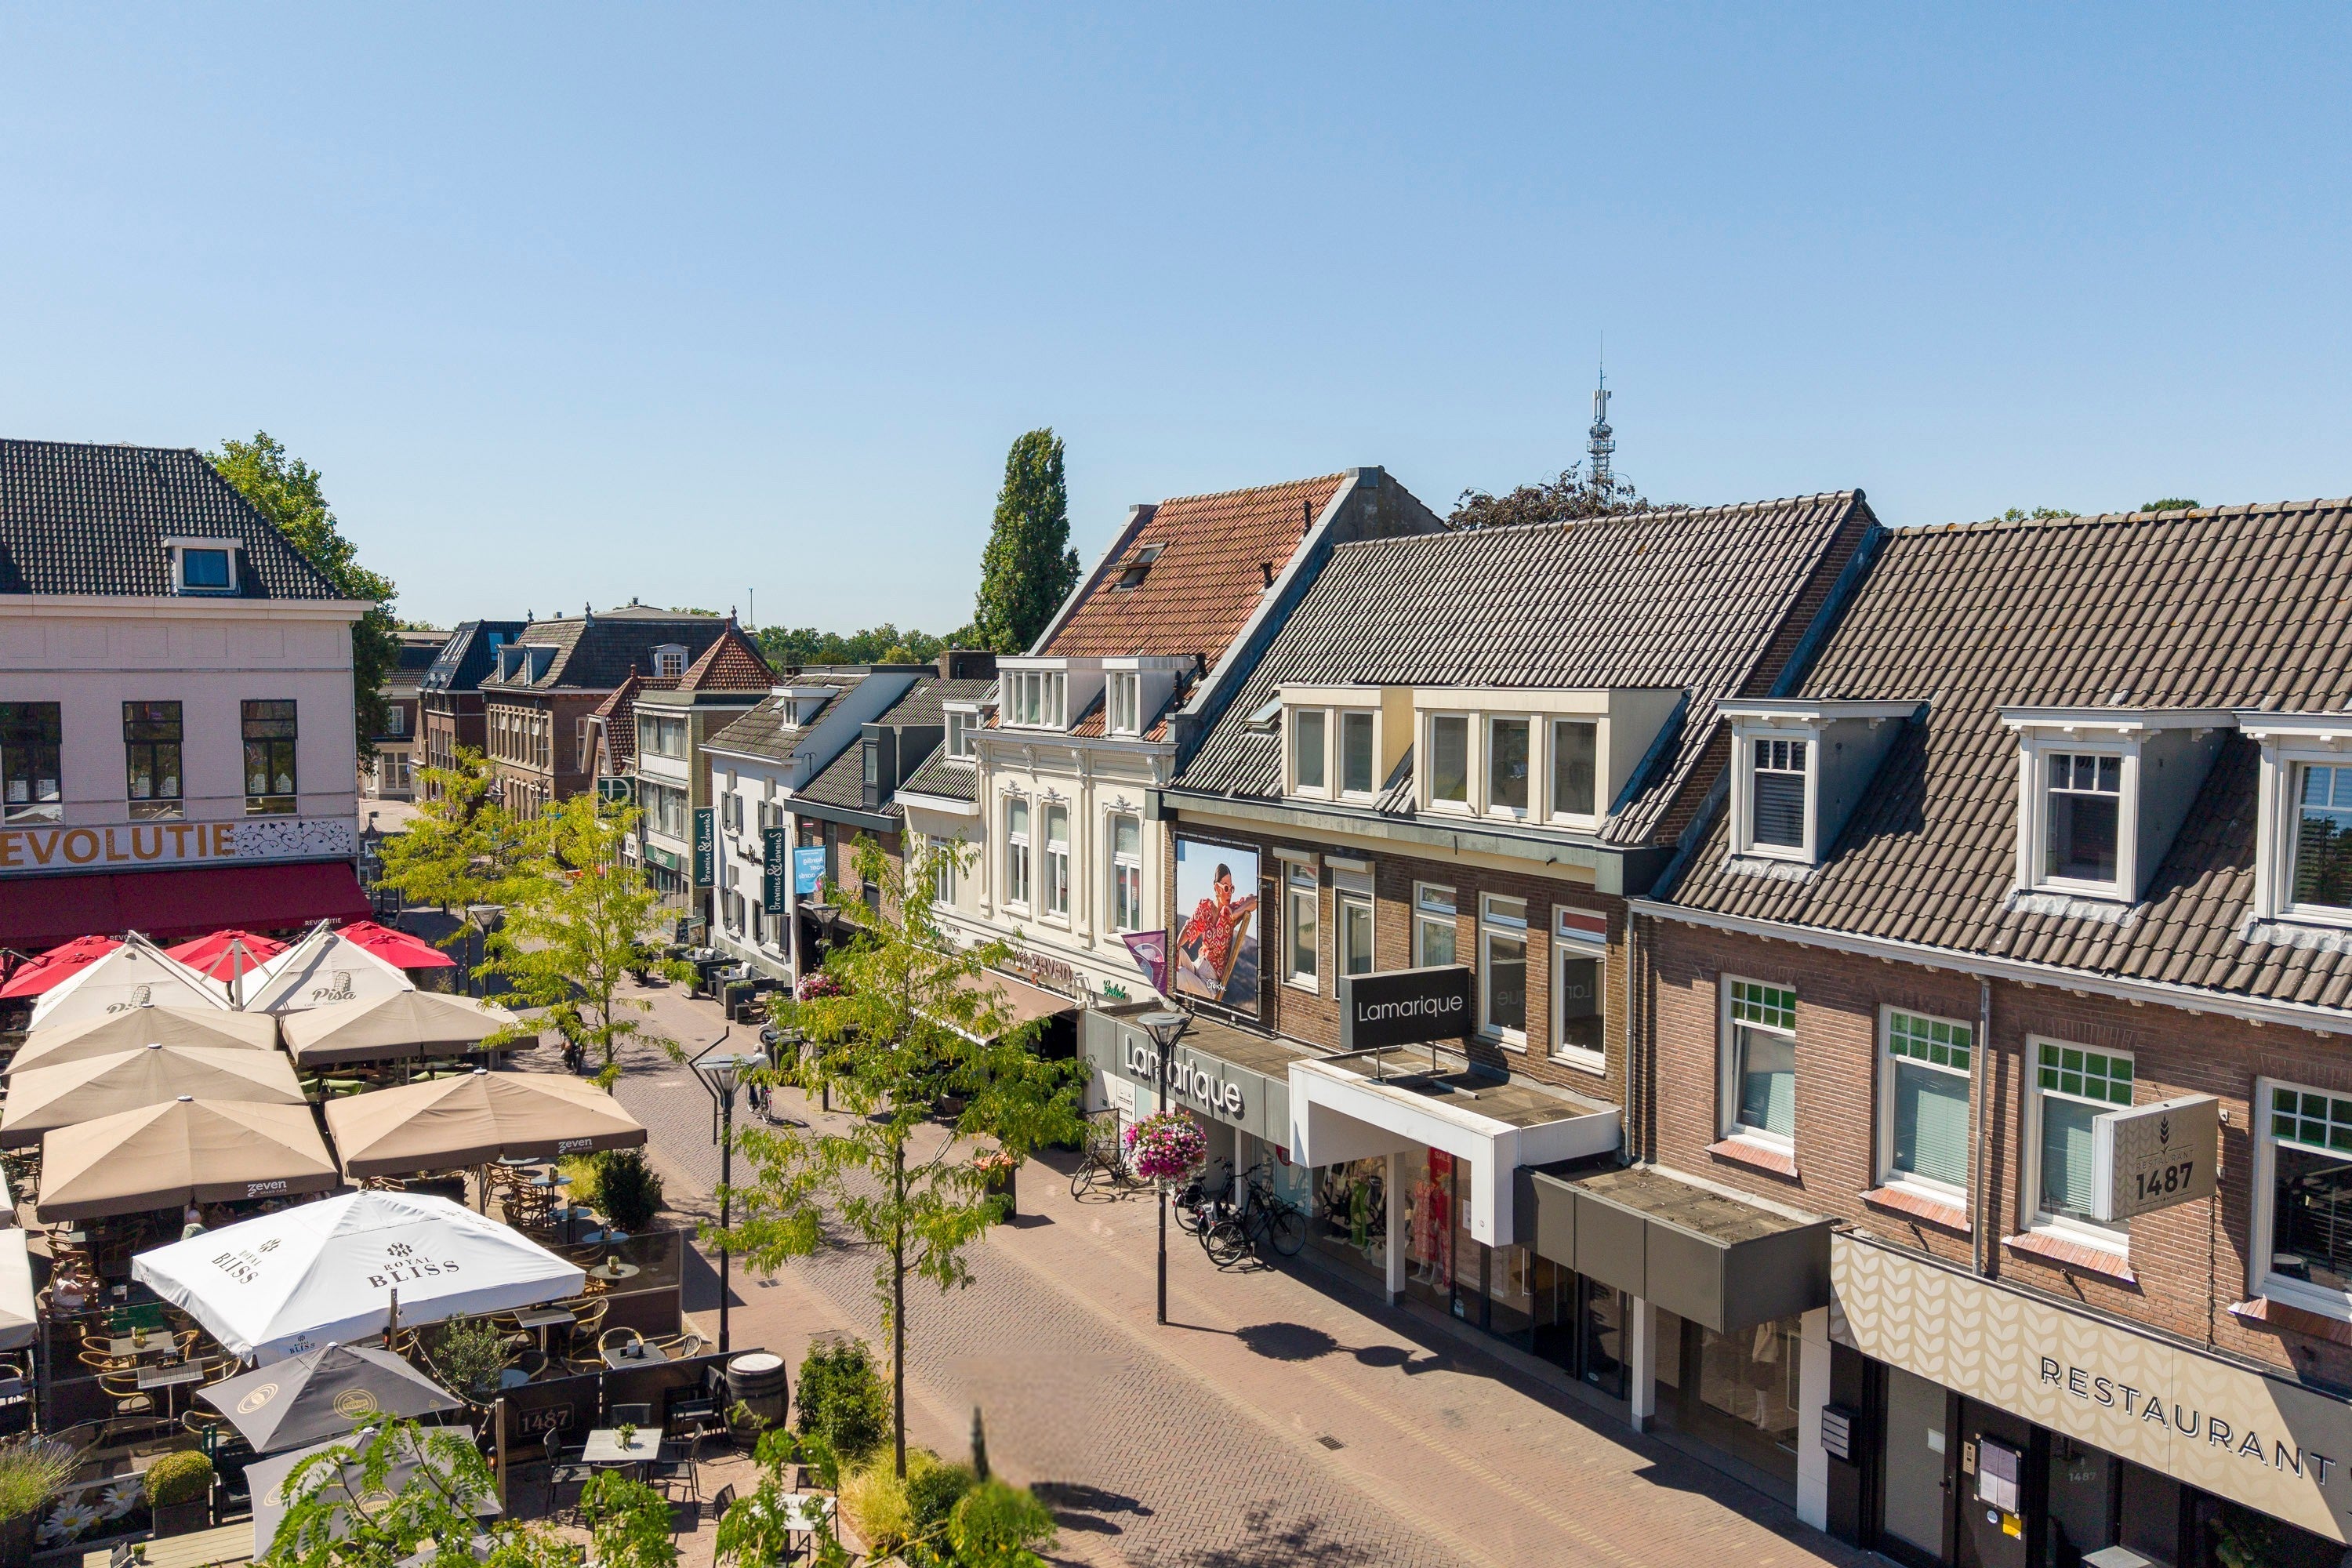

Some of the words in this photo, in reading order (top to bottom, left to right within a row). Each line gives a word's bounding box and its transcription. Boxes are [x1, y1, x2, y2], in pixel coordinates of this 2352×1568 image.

[699, 852, 711, 883] Brownies
[768, 877, 781, 910] Brownies
[312, 988, 356, 1002] Pisa
[1359, 995, 1463, 1022] Lamarique
[1125, 1034, 1241, 1112] Lamarique
[558, 1138, 593, 1154] zeven
[1434, 1151, 1451, 1163] SALE
[2136, 1149, 2194, 1171] RESTAURANT
[247, 1181, 287, 1197] zeven
[2136, 1161, 2194, 1200] 1487
[212, 1252, 259, 1284] BLISS
[238, 1250, 263, 1267] ROYAL
[383, 1257, 433, 1271] ROYAL
[367, 1260, 459, 1288] BLISS
[289, 1342, 315, 1354] BLISS
[522, 1410, 568, 1432] 1487
[2041, 1356, 2337, 1486] RESTAURANT
[2068, 1472, 2096, 1483] 1487
[361, 1501, 387, 1512] Lipton
